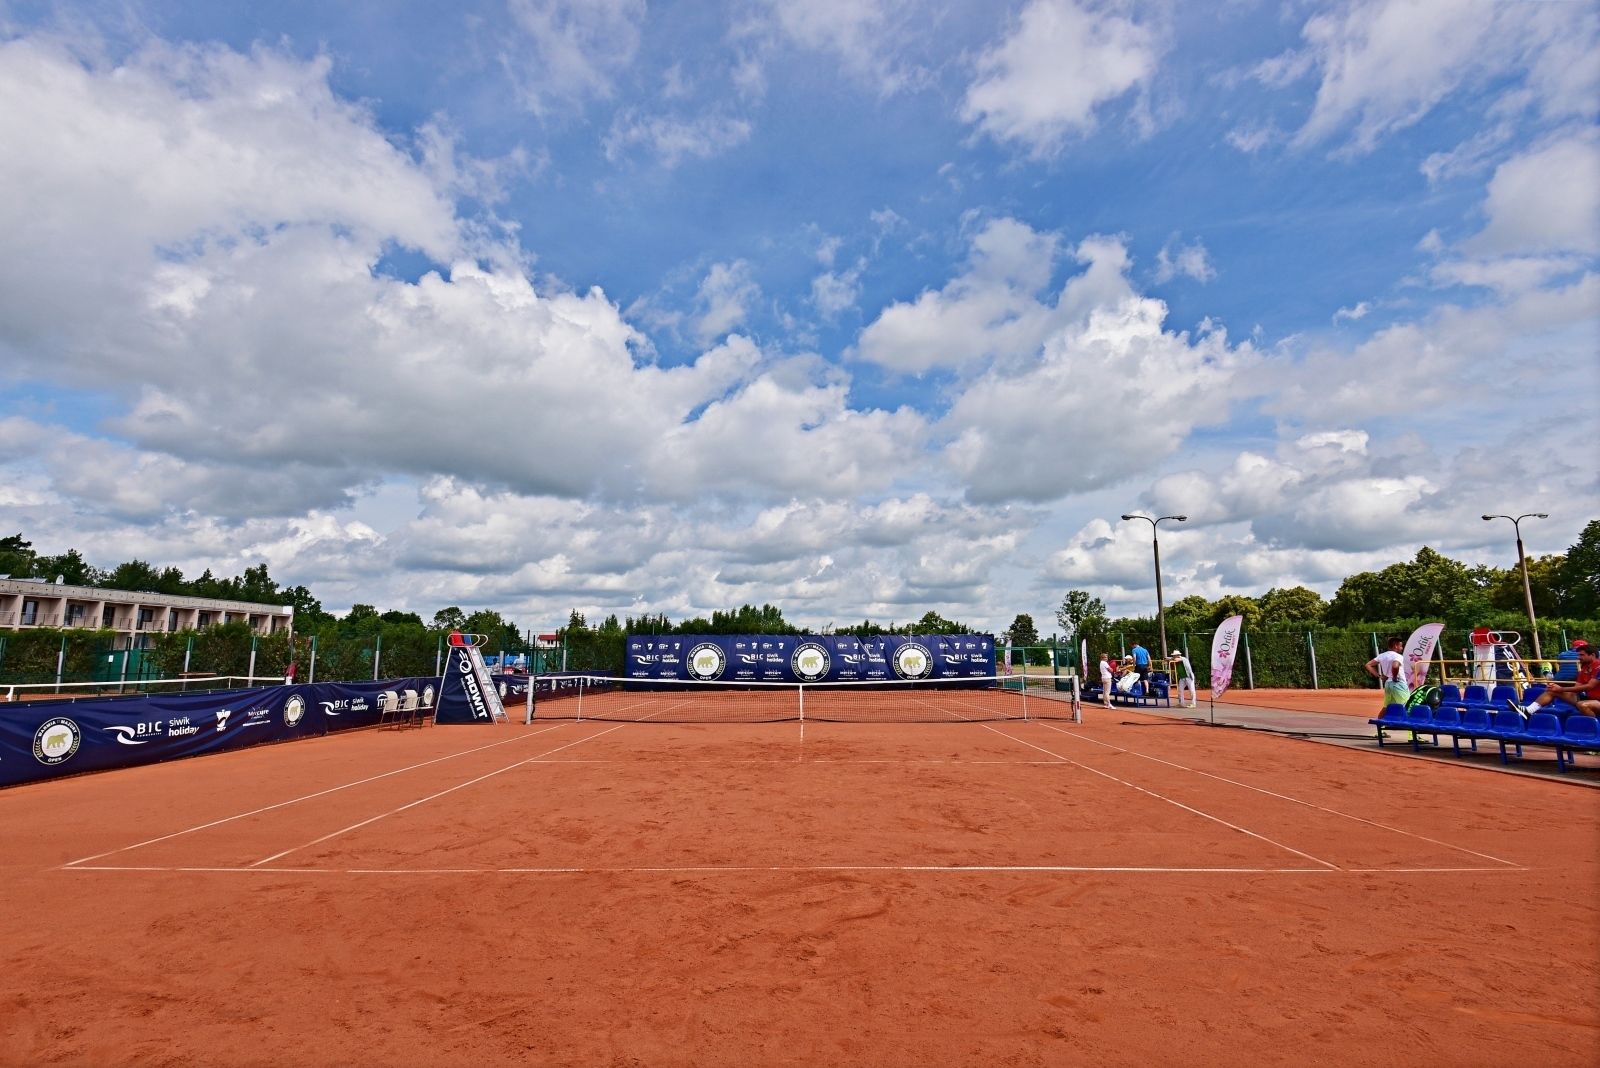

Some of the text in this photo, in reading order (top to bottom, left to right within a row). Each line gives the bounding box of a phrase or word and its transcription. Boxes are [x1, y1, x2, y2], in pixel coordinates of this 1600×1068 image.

[465, 673, 488, 718] ROWIT
[334, 699, 349, 708] BIC
[136, 721, 162, 734] BIC
[168, 716, 190, 727] siwik
[38, 720, 78, 737] WARMIA MAZURY
[168, 726, 200, 737] holiday
